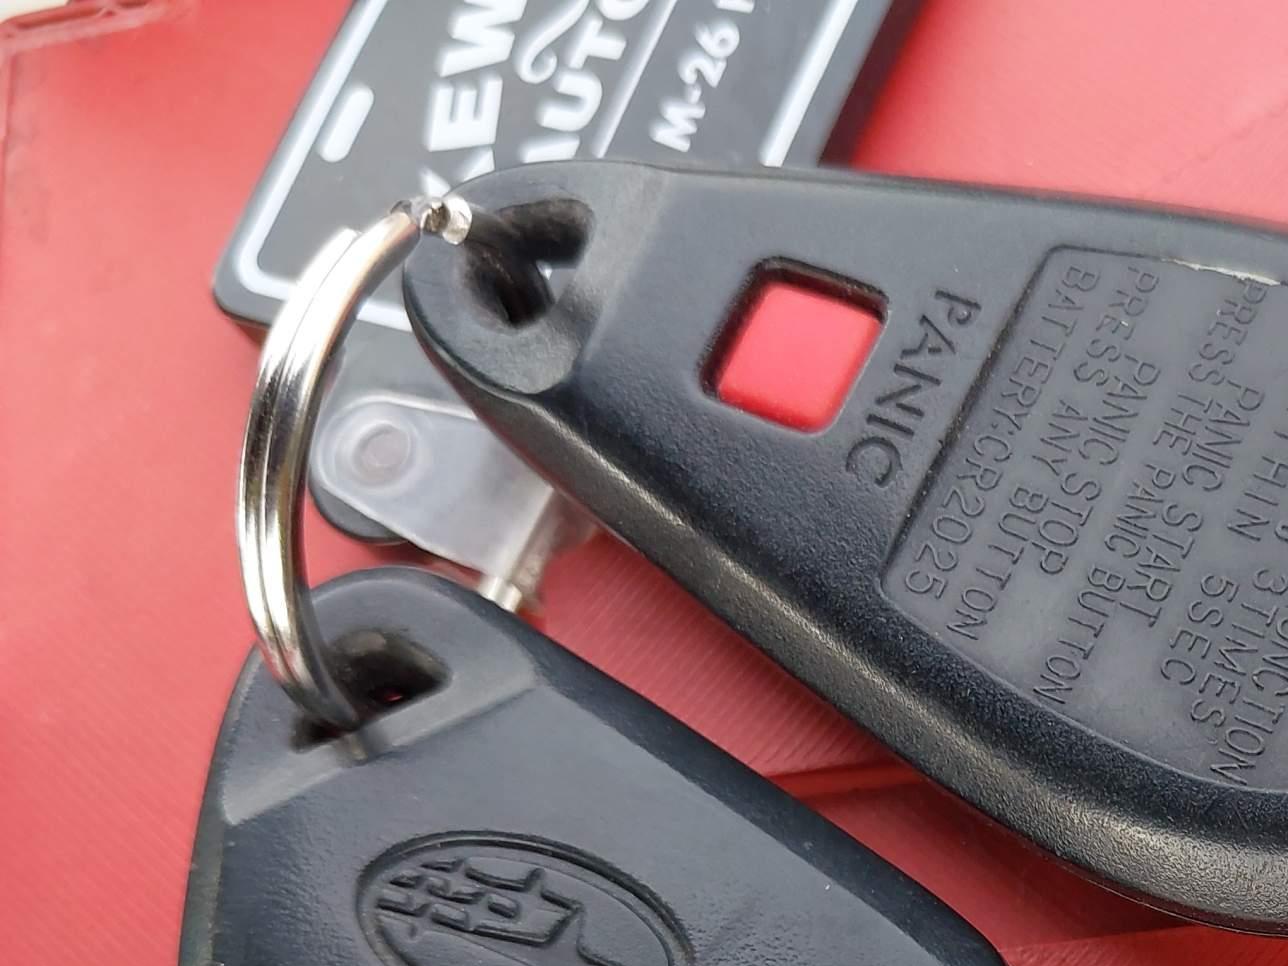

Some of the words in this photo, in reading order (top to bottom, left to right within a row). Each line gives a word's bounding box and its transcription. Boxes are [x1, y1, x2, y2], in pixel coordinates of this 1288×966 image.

[650, 18, 741, 153] M-26
[846, 288, 982, 487] PANIC
[1070, 266, 1158, 392] PRESS
[1186, 276, 1266, 390] PRESS
[1028, 400, 1088, 475] ANY
[1076, 353, 1160, 470] PANIC
[1152, 386, 1212, 457] THE
[1180, 378, 1263, 494] PANIC
[945, 484, 1047, 641] BUTTON
[1023, 469, 1102, 578] STOP
[1102, 462, 1175, 560] PANIC
[1116, 501, 1203, 628] START
[1032, 565, 1125, 704] BUTTON
